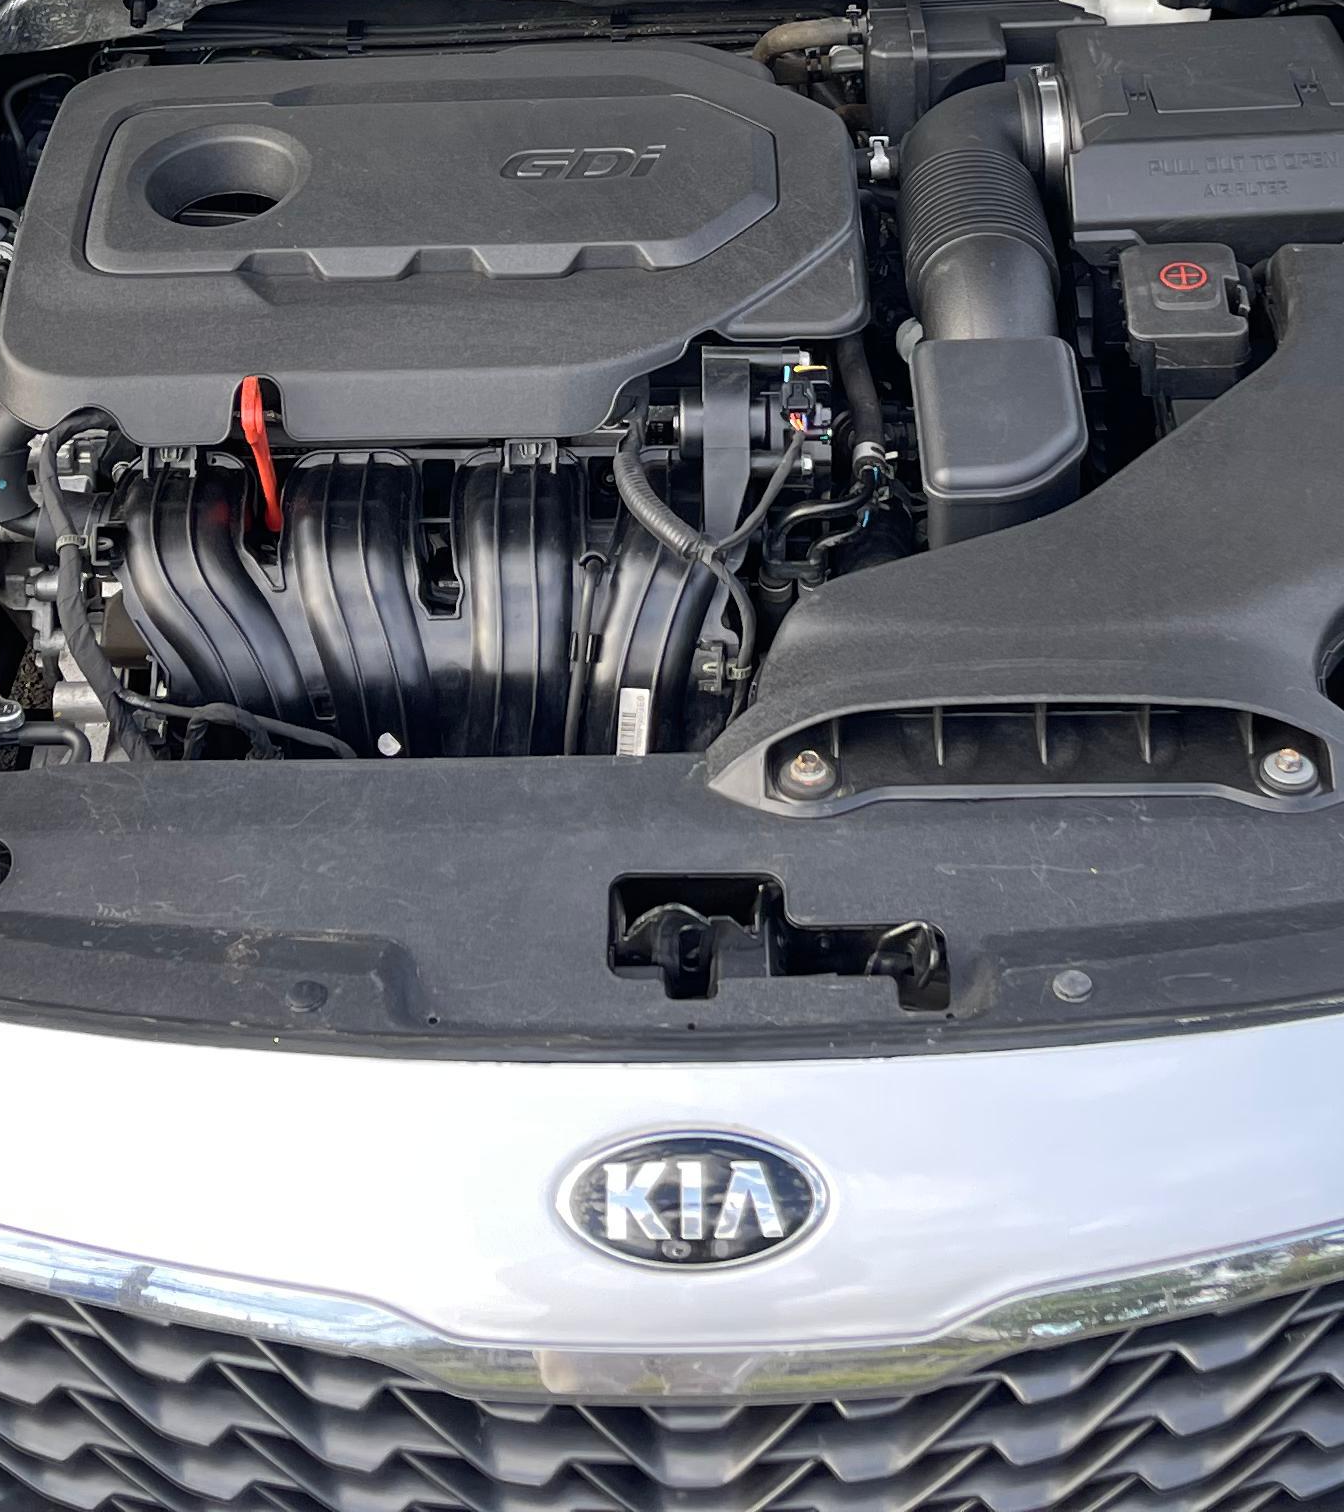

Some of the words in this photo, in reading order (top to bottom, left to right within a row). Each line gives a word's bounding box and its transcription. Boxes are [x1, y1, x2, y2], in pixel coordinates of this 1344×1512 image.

[500, 144, 667, 181] GDi
[1148, 159, 1201, 177] PULL
[1206, 155, 1245, 174] OUT
[1250, 154, 1277, 172] TO
[1282, 152, 1340, 170] OPEN
[603, 1160, 784, 1240] KIA
